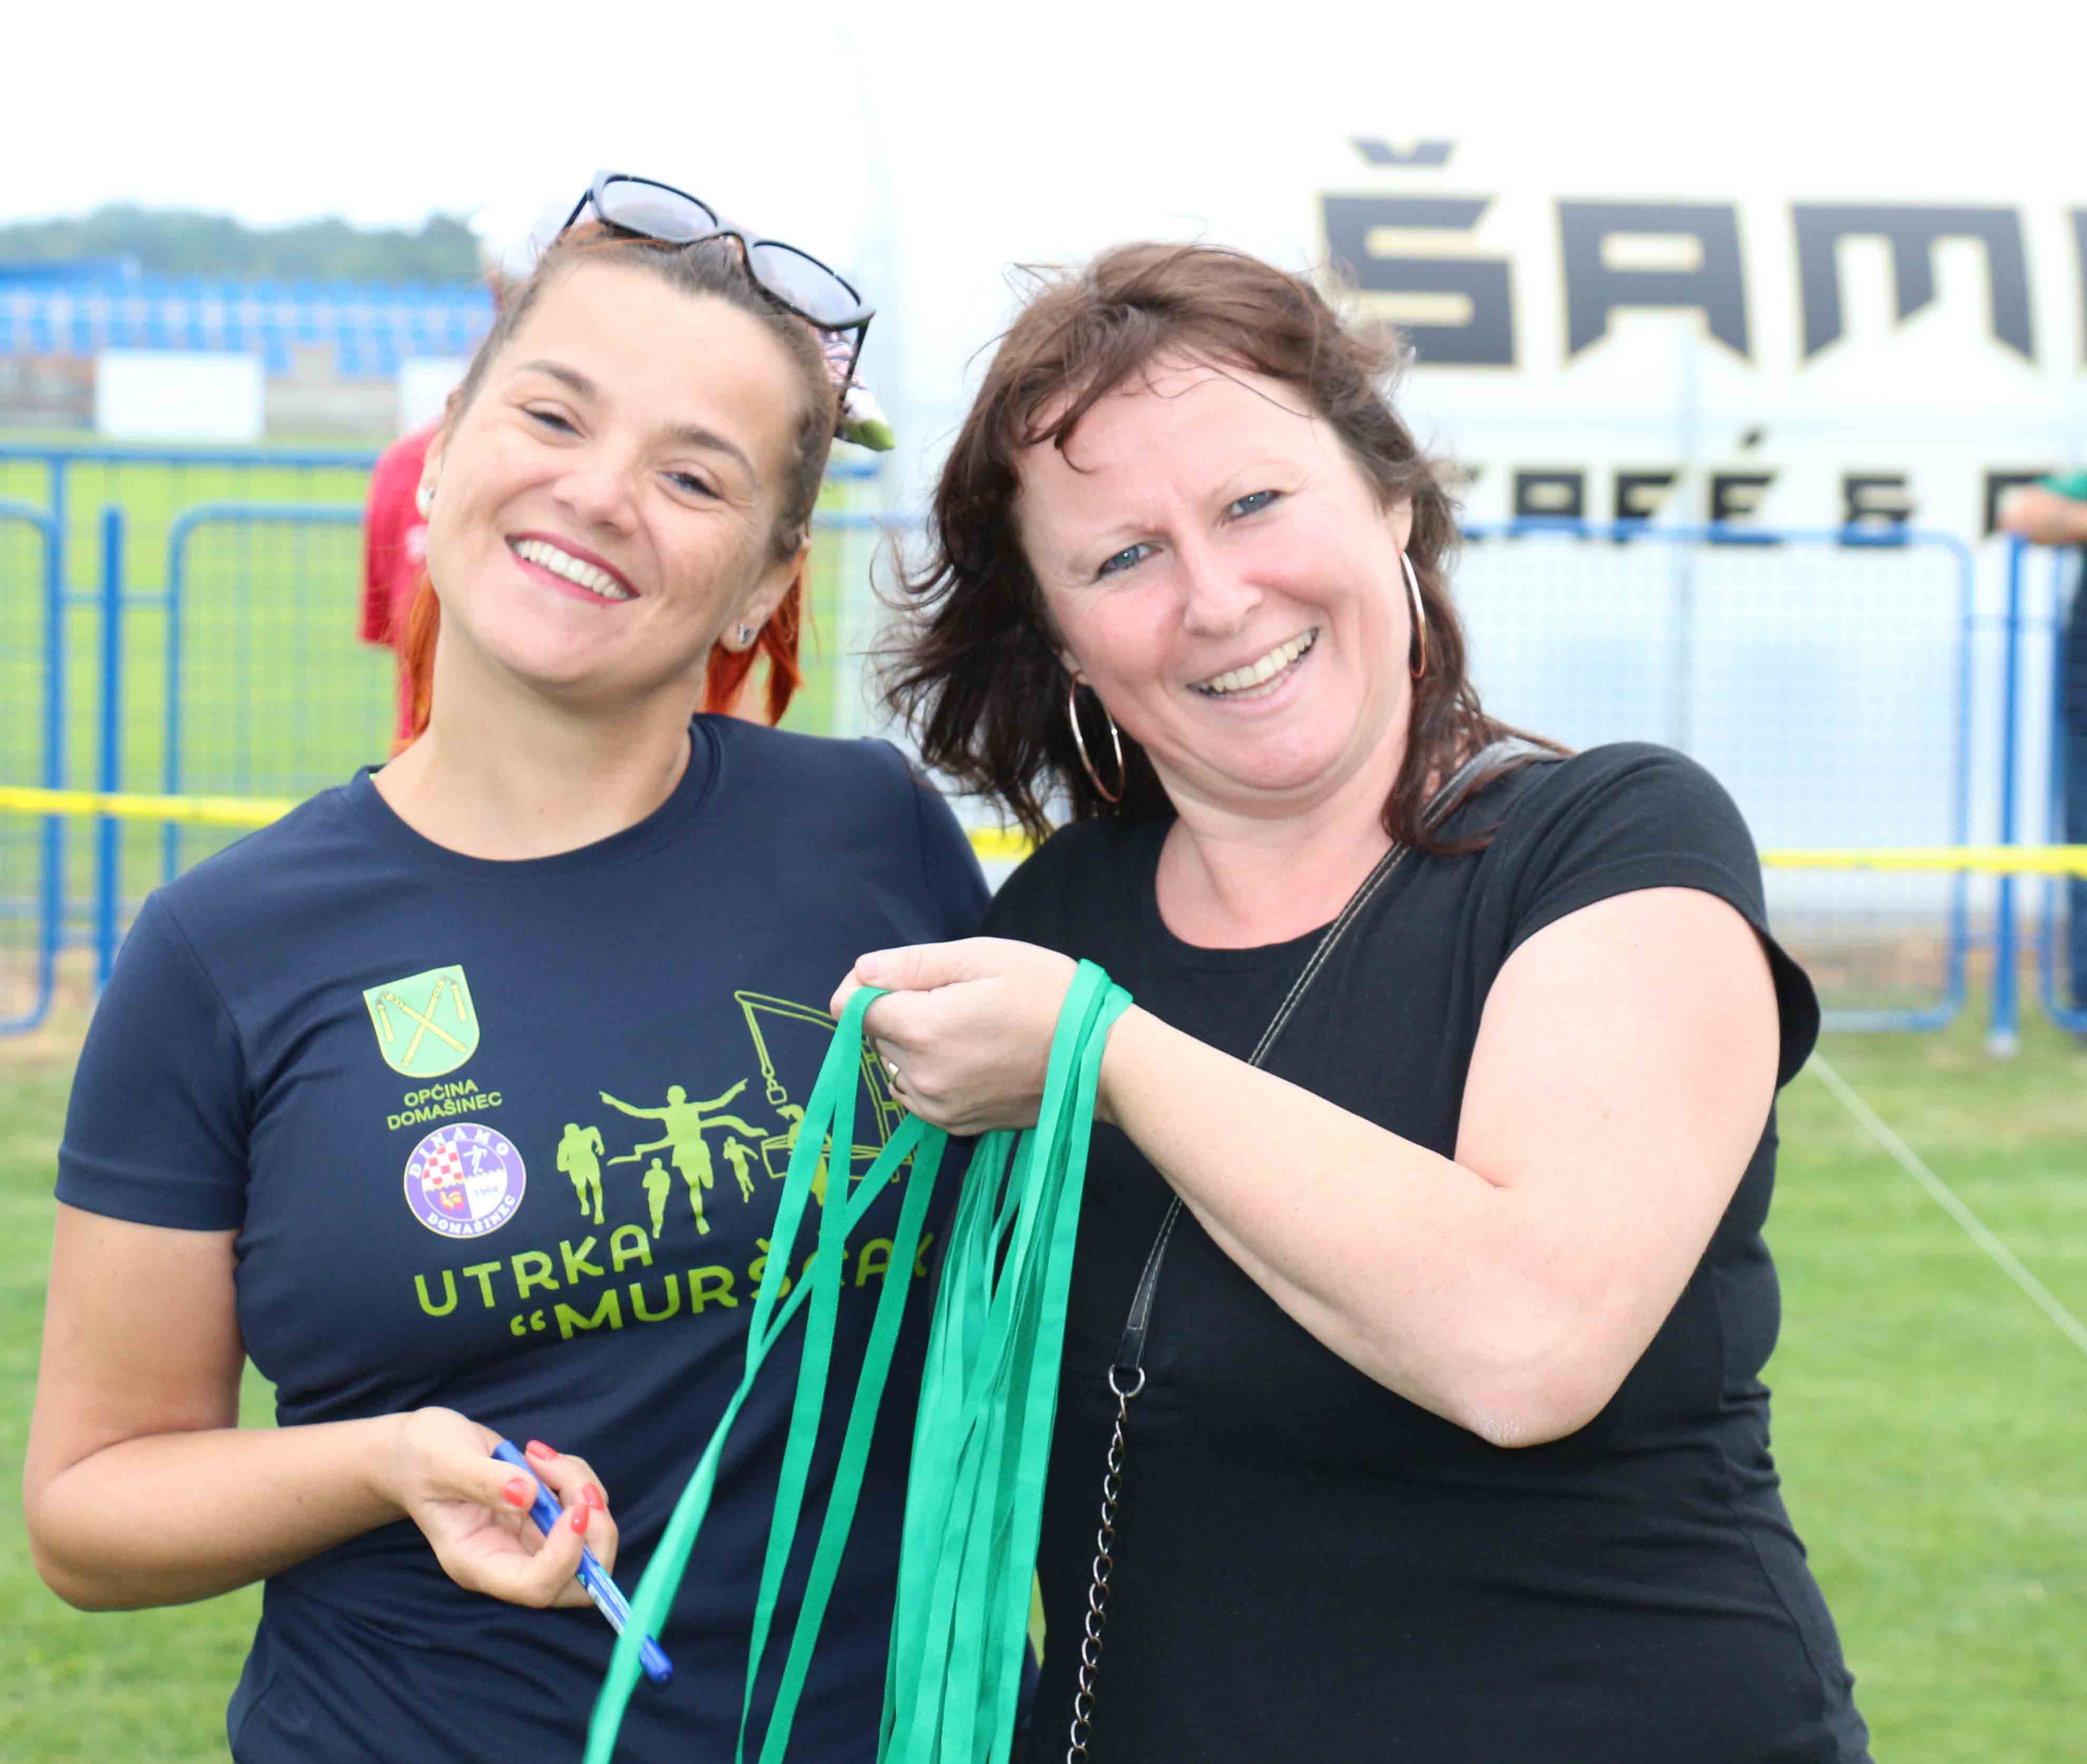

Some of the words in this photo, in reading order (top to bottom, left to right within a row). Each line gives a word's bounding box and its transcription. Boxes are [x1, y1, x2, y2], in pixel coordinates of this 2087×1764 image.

[1316, 137, 2087, 371] ŠAM
[1461, 425, 1786, 546] AFÉ
[1837, 469, 1918, 547] &
[386, 1091, 503, 1130] DOMAŠINEC
[408, 1126, 510, 1179] DINAMO
[413, 1224, 654, 1317] UTRKA
